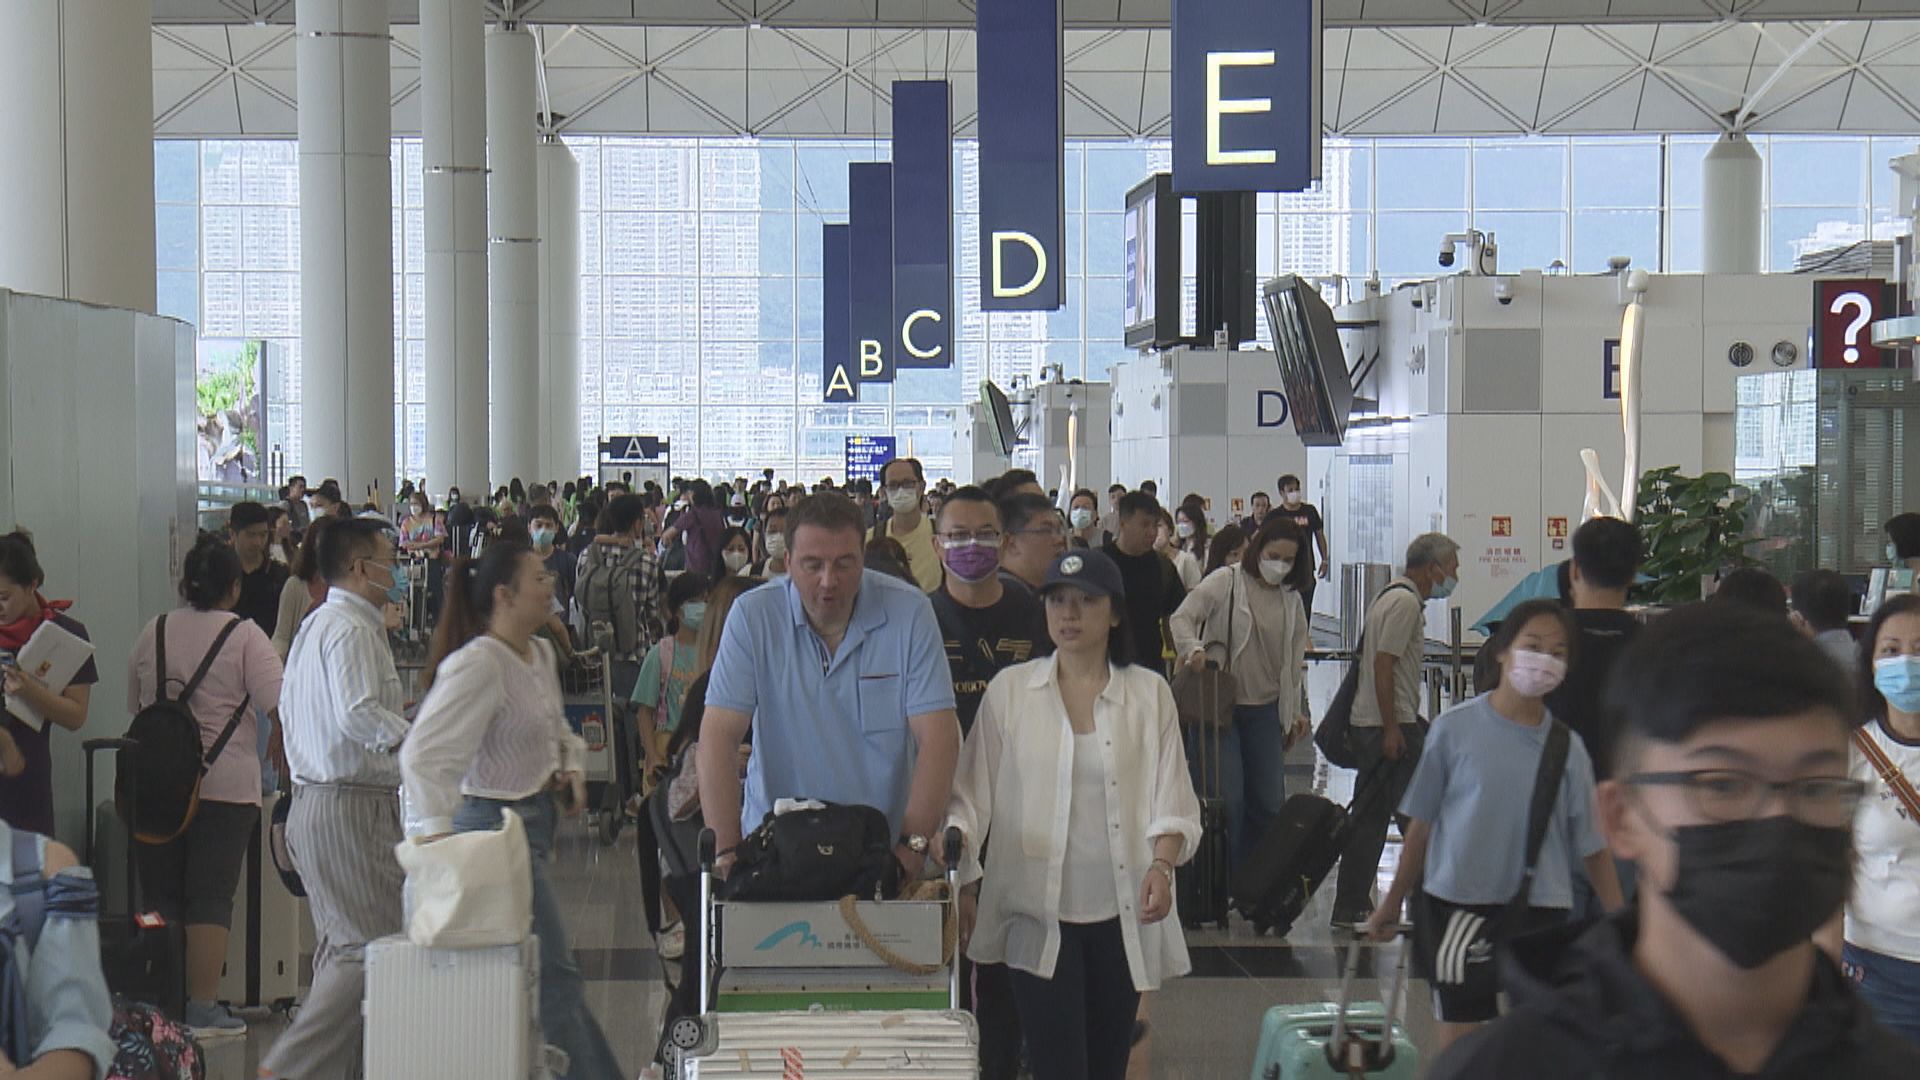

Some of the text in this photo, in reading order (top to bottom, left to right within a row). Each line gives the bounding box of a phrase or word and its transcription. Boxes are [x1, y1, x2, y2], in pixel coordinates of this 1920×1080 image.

[1206, 50, 1276, 165] E
[991, 231, 1047, 298] D
[902, 310, 942, 358] C
[1830, 291, 1872, 364] ?
[861, 340, 883, 377] B
[825, 364, 854, 397] A
[1258, 390, 1288, 427] D
[624, 437, 645, 460] A
